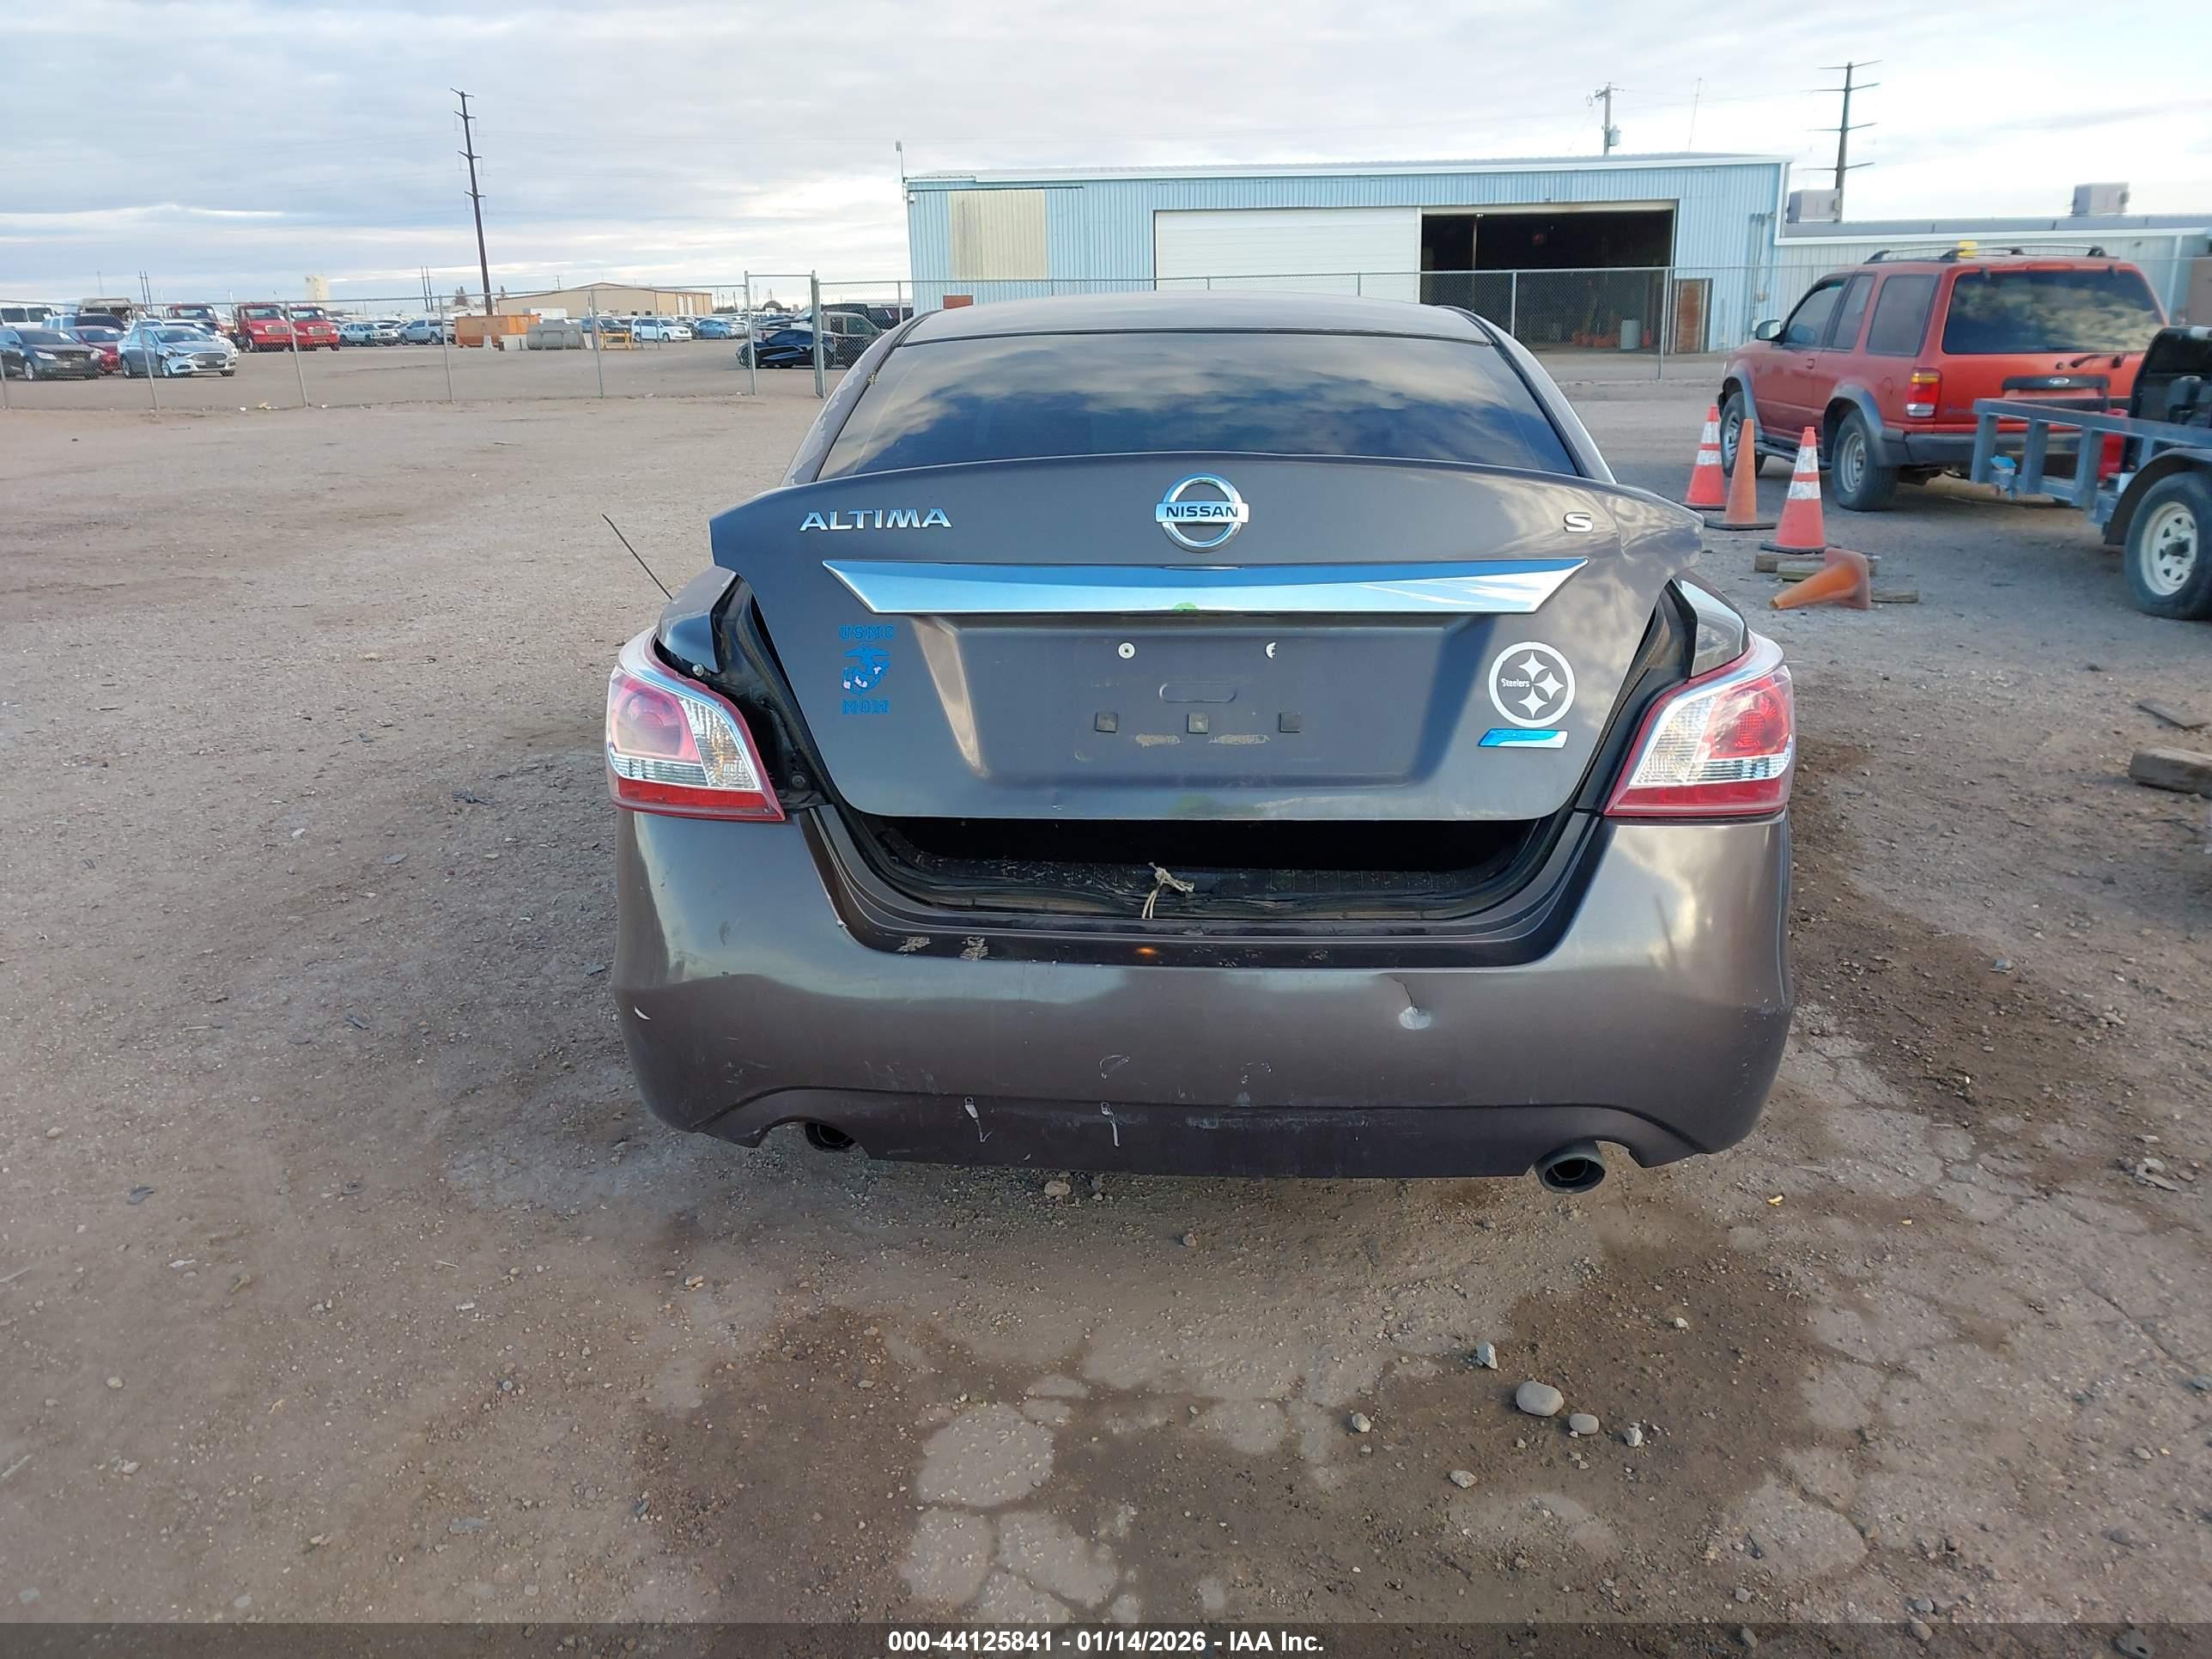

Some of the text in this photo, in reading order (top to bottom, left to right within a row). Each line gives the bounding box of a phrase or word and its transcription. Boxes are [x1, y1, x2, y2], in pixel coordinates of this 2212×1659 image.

[799, 507, 952, 532] ALTIMA
[1166, 506, 1238, 517] NISSAN
[1563, 512, 1594, 533] S
[838, 624, 895, 640] USMC
[1501, 678, 1530, 688] Steelers
